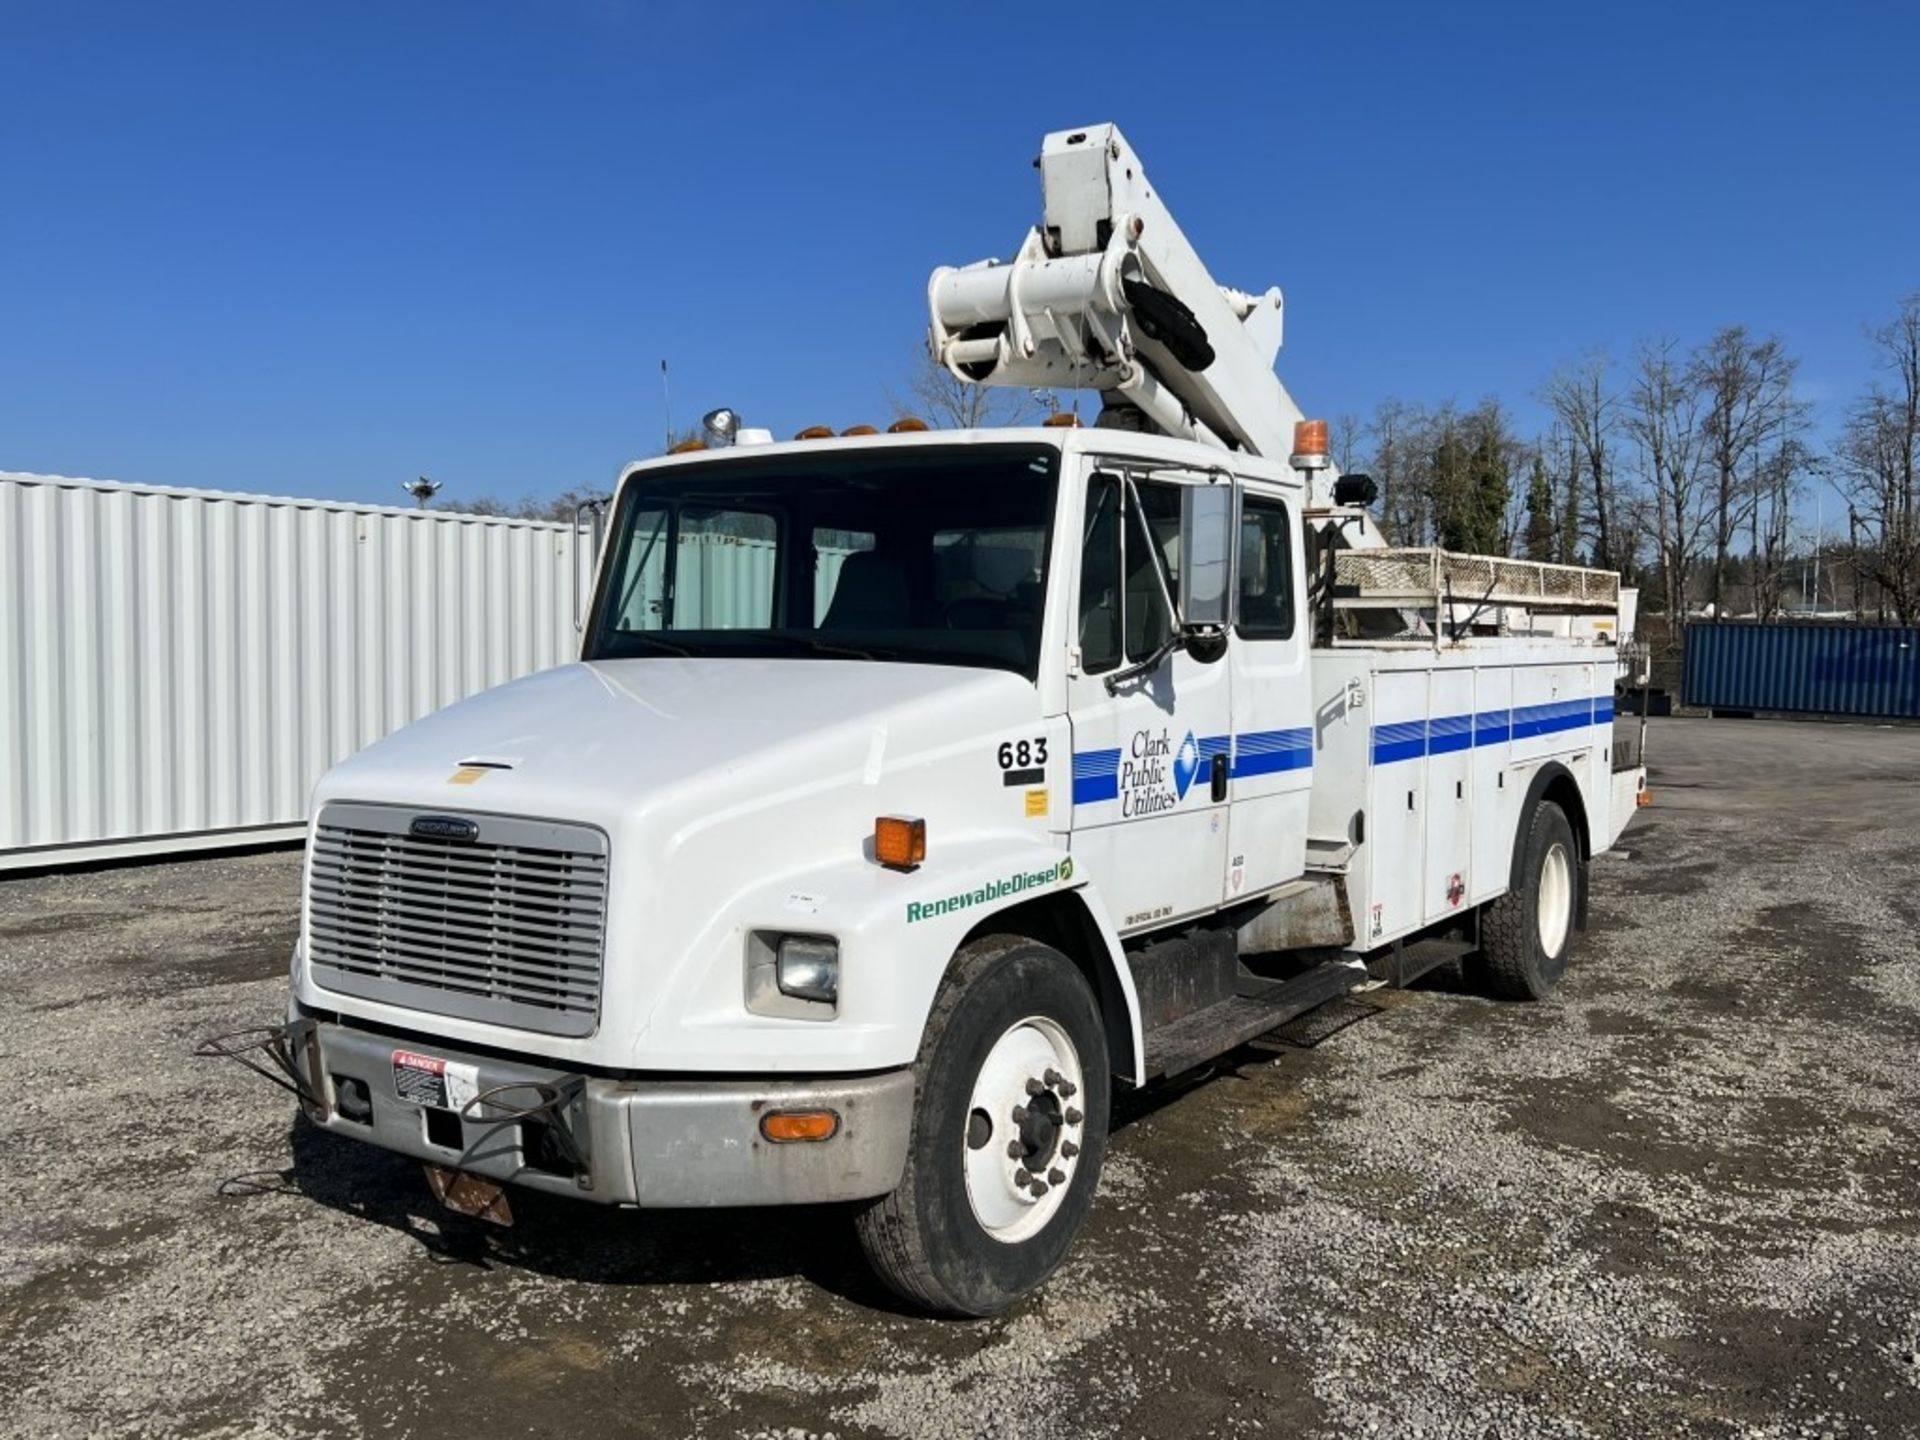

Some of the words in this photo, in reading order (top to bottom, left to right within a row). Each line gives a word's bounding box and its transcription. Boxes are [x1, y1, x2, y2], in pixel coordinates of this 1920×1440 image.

[998, 736, 1048, 769] 683
[1132, 728, 1170, 758] Clark
[1120, 757, 1165, 790] Public
[1122, 786, 1176, 818] Utilities
[906, 863, 1058, 923] RenewableDiesel
